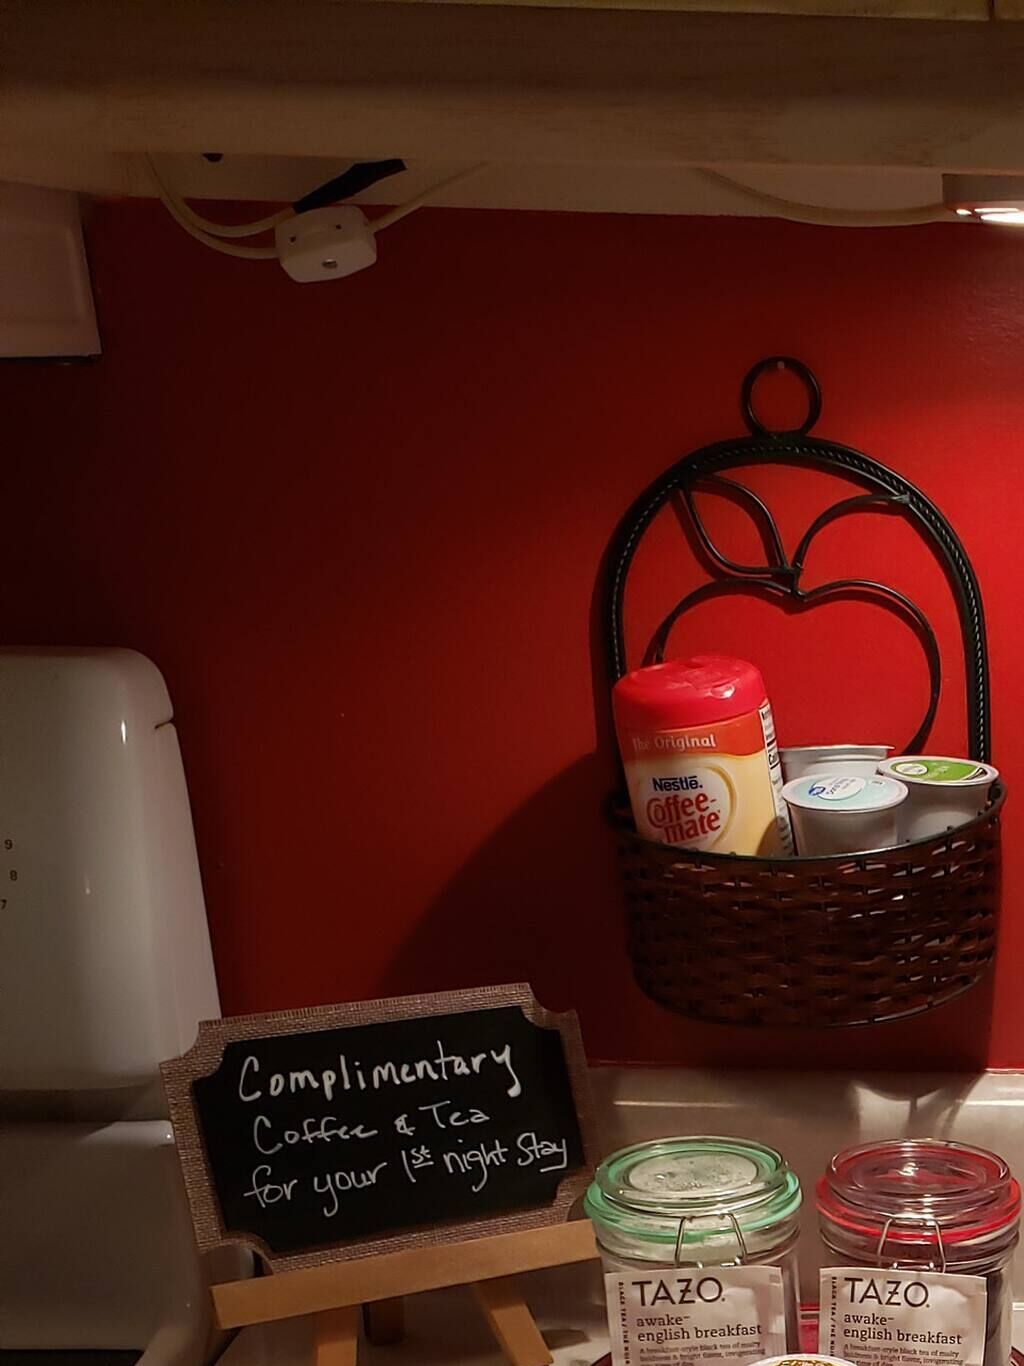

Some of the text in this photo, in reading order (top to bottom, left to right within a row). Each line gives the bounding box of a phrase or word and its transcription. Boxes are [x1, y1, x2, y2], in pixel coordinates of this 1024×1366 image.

[654, 734, 717, 753] Original
[662, 811, 722, 844] mate
[4, 839, 13, 850] 9
[9, 869, 18, 881] 8
[238, 1040, 523, 1102] Complimentary
[253, 1100, 491, 1155] Coffee & Tea
[243, 1165, 299, 1209] for
[313, 1161, 389, 1218] your
[401, 1143, 435, 1183] 1st
[441, 1138, 509, 1193] night
[637, 1323, 763, 1345] english breakfast
[843, 1327, 963, 1346] english breakfast
